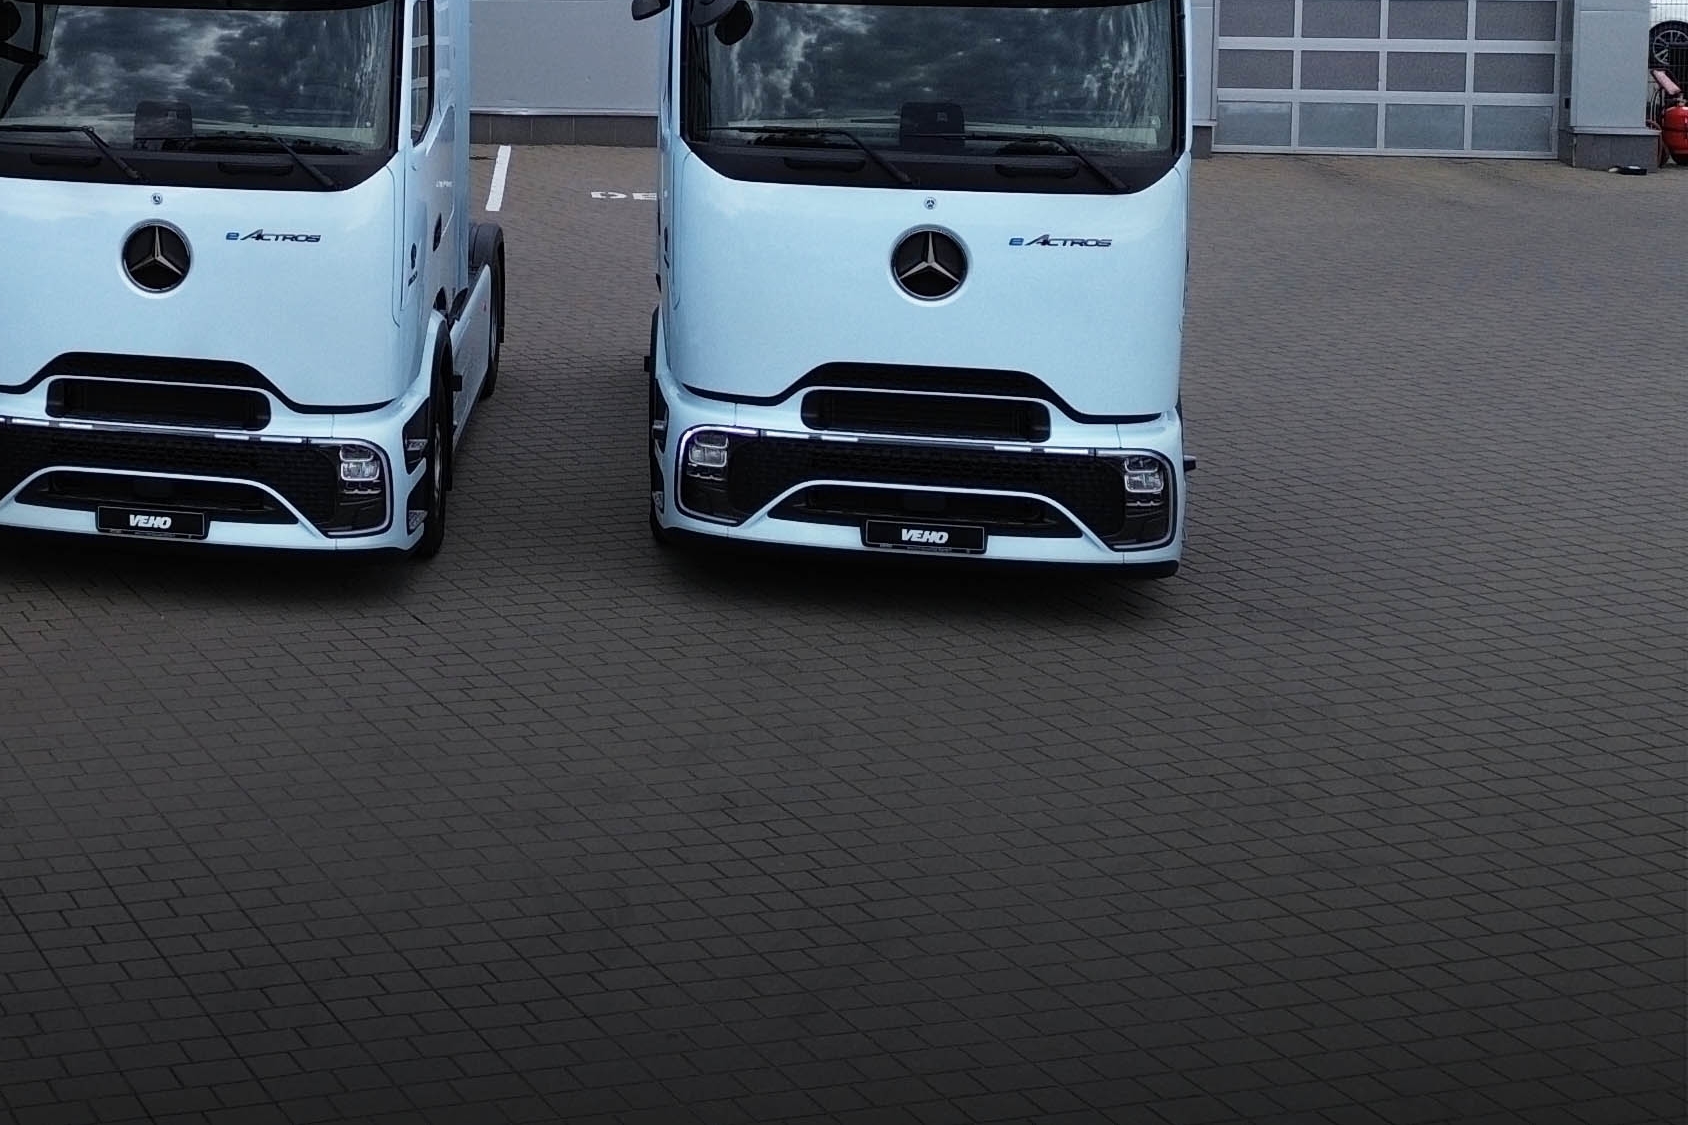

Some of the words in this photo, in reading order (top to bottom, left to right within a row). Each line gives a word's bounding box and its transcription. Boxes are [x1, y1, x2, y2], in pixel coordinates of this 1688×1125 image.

[591, 191, 657, 201] DE
[129, 514, 172, 529] VEHO
[901, 528, 949, 544] VEHO
